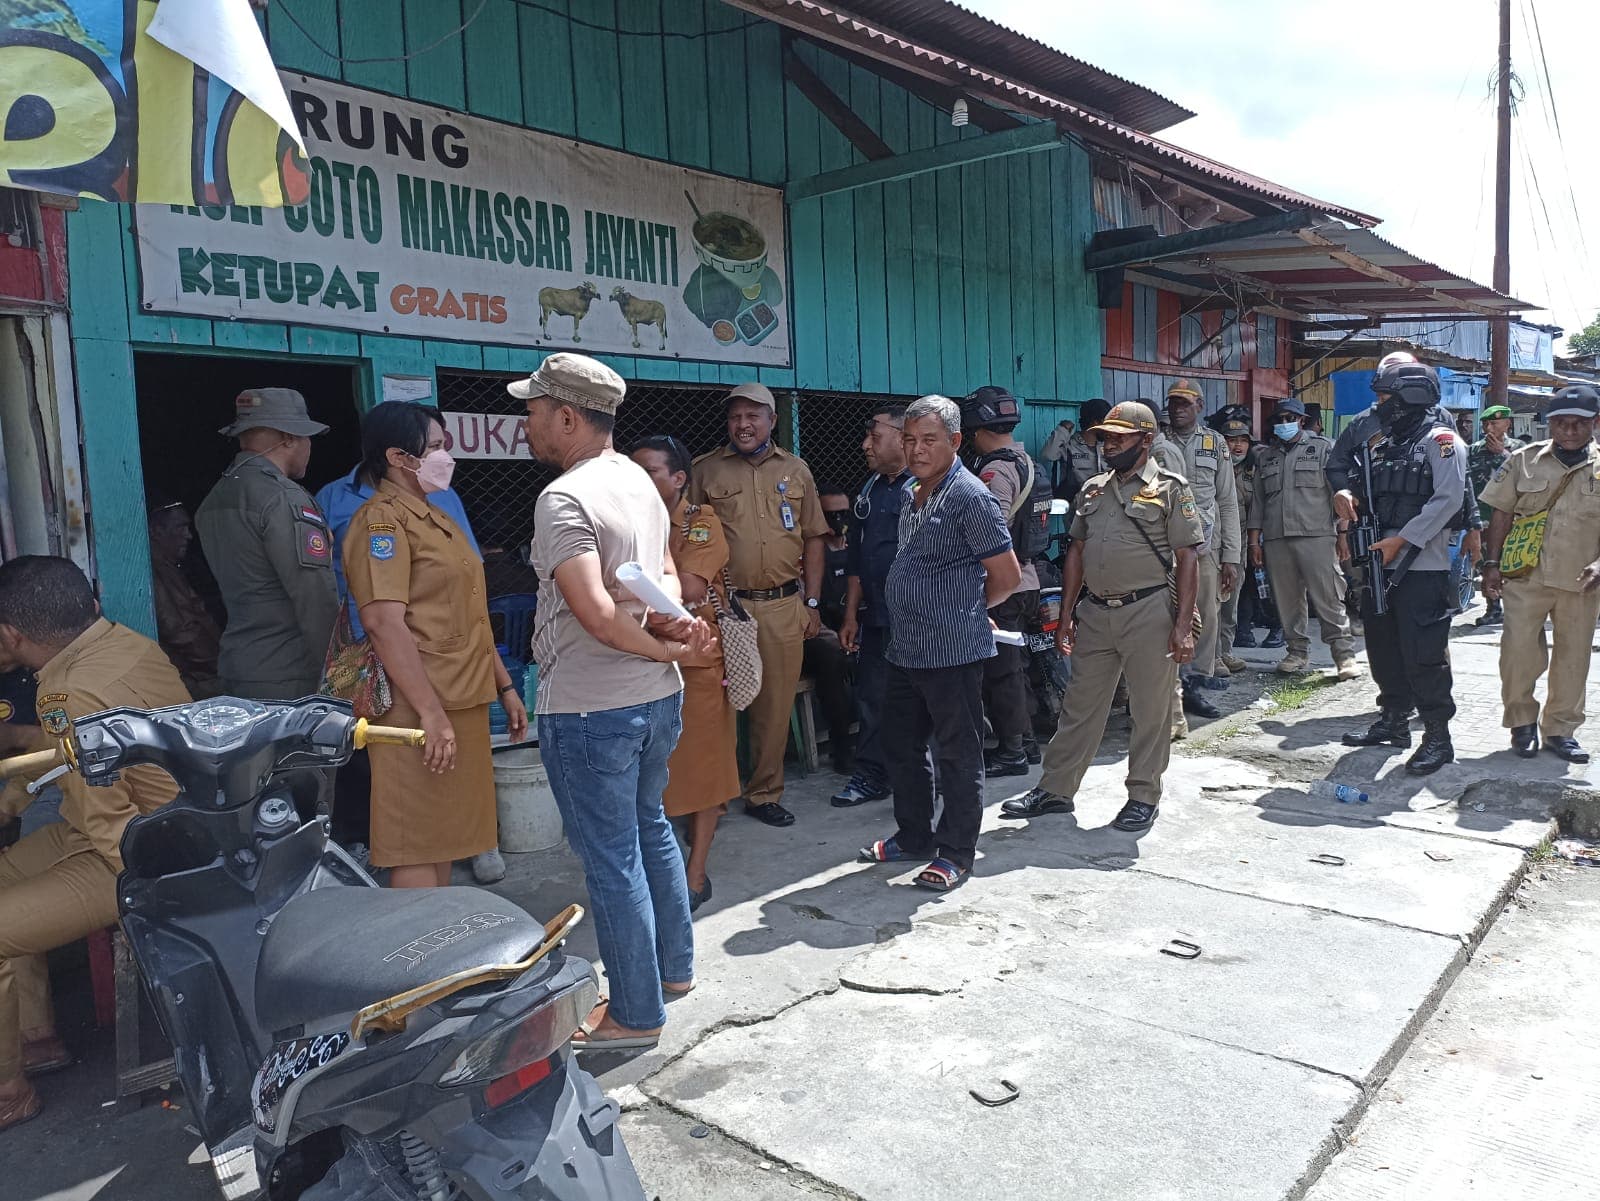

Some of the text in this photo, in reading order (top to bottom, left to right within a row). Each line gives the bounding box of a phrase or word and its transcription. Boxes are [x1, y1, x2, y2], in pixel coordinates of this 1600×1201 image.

[397, 173, 572, 272] MAKASSAR
[585, 210, 679, 287] JAYANTI
[178, 246, 508, 324] KETUPAT GRATIS
